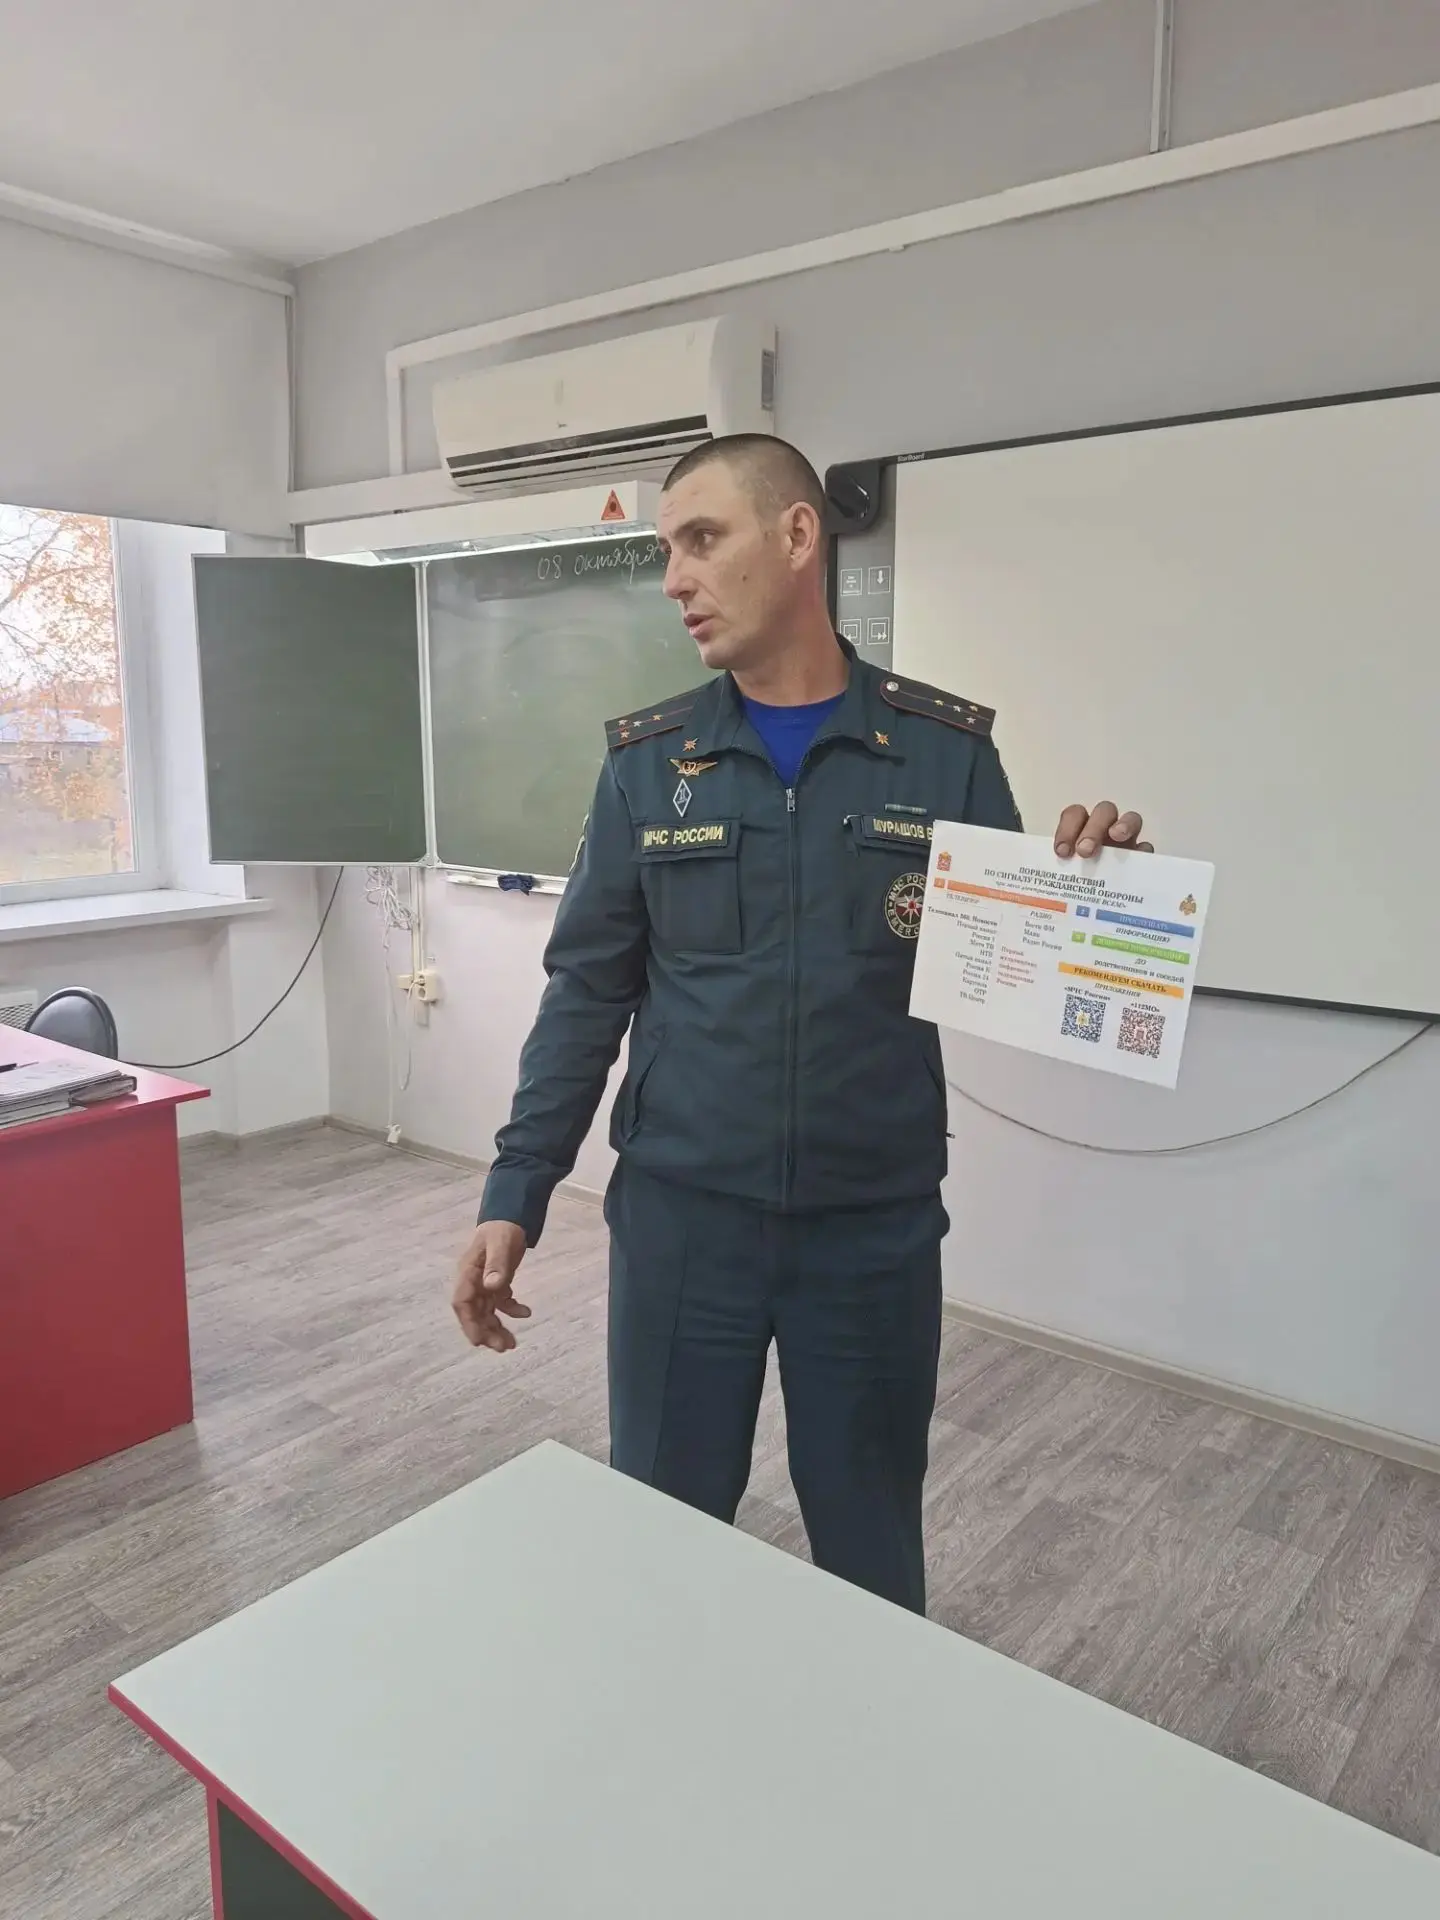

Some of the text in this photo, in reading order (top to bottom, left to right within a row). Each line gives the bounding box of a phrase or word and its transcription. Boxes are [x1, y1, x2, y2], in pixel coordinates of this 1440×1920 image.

[537, 555, 562, 580] 08
[643, 825, 724, 846] МЧС РОССИИ
[873, 818, 925, 839] МУРАШОВ
[984, 868, 996, 876] ПО
[996, 871, 1033, 884] СИГНАЛУ
[1033, 878, 1097, 896] ГРАЖДАНСКОЙ
[1098, 889, 1144, 904] ОБОРОНЫ
[1019, 867, 1105, 888] ПОРЯДОК ДЕЙСТВИЙ
[888, 879, 904, 901] МЧС
[1074, 967, 1166, 993] РЕКОМЕНДУЕМ СКАЧАТЬ
